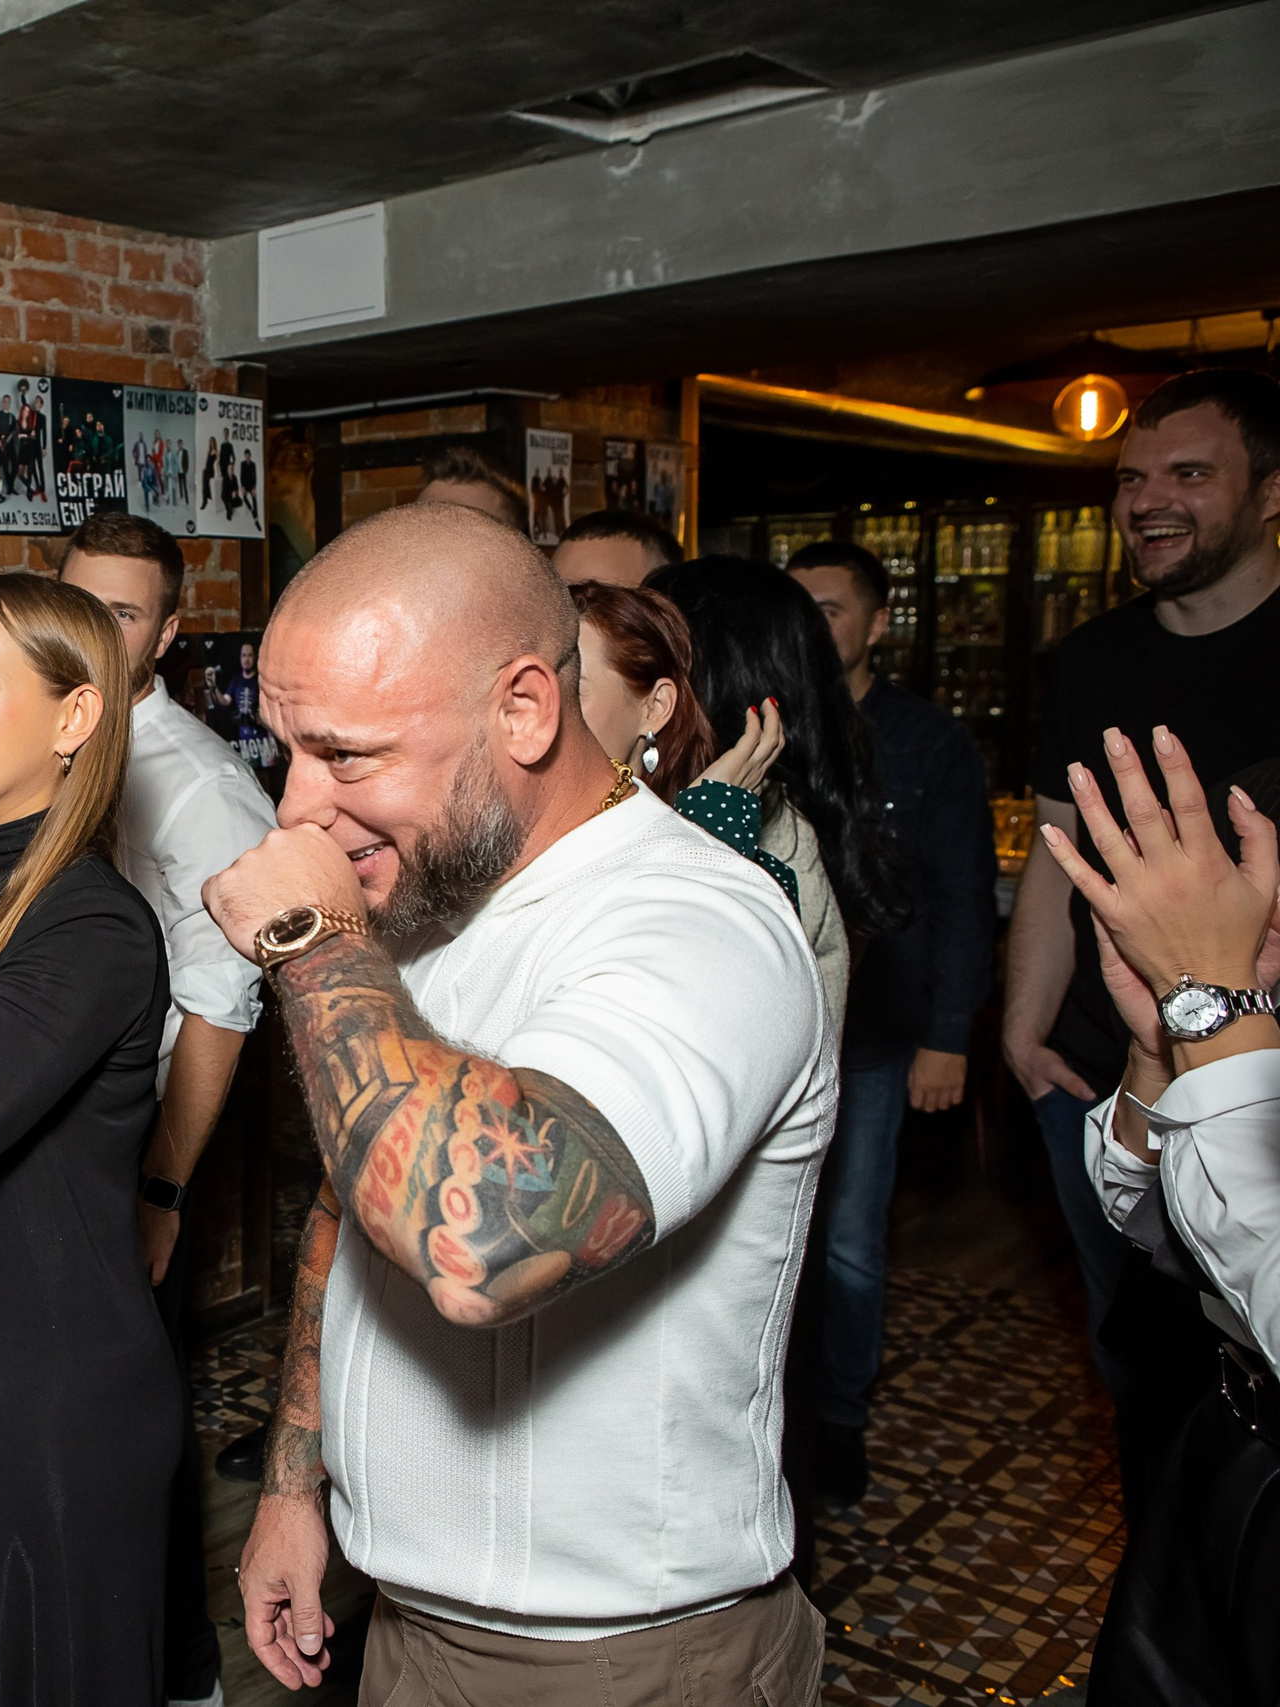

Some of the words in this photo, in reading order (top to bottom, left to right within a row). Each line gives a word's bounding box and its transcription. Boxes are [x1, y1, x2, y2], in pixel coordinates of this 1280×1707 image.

[218, 400, 262, 422] DESERT
[232, 422, 260, 442] ROSE
[57, 469, 126, 498] СЫГРАЙ
